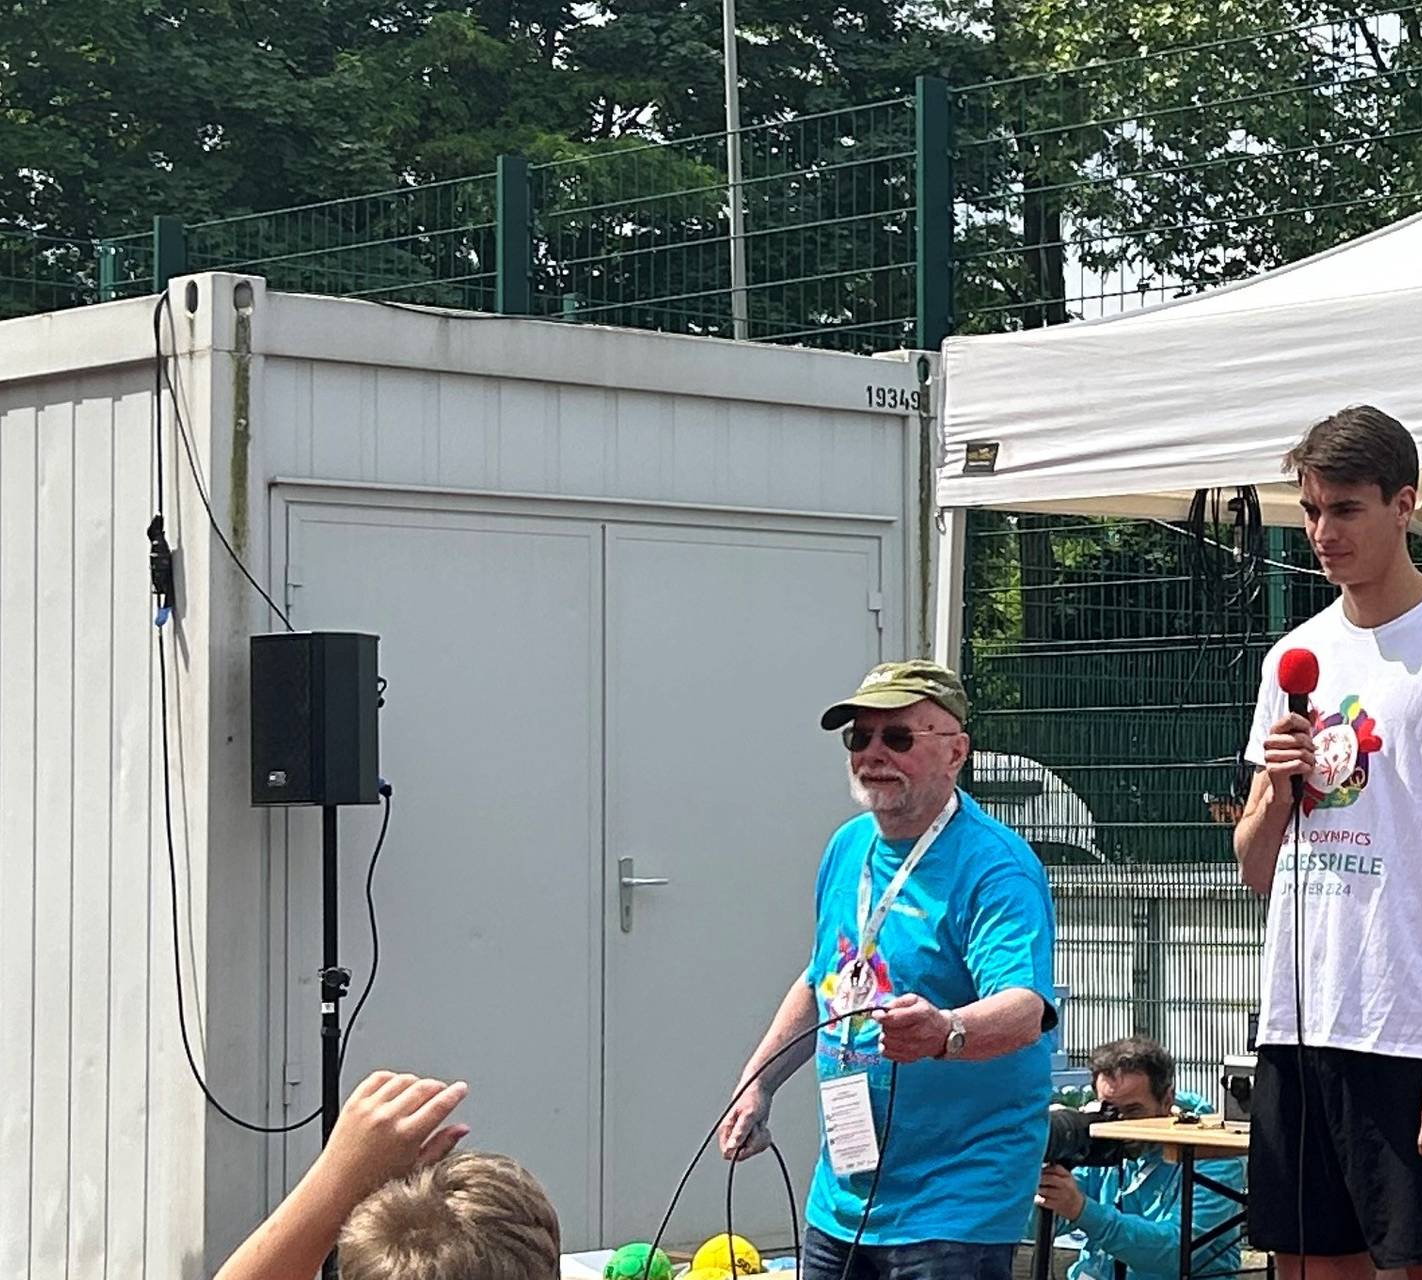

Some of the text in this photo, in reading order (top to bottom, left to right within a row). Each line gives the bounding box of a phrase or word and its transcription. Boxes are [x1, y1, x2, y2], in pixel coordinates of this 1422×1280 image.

[866, 385, 920, 410] 19349
[1309, 830, 1371, 846] OLYMPICS
[1279, 852, 1383, 875] DESSPIELE
